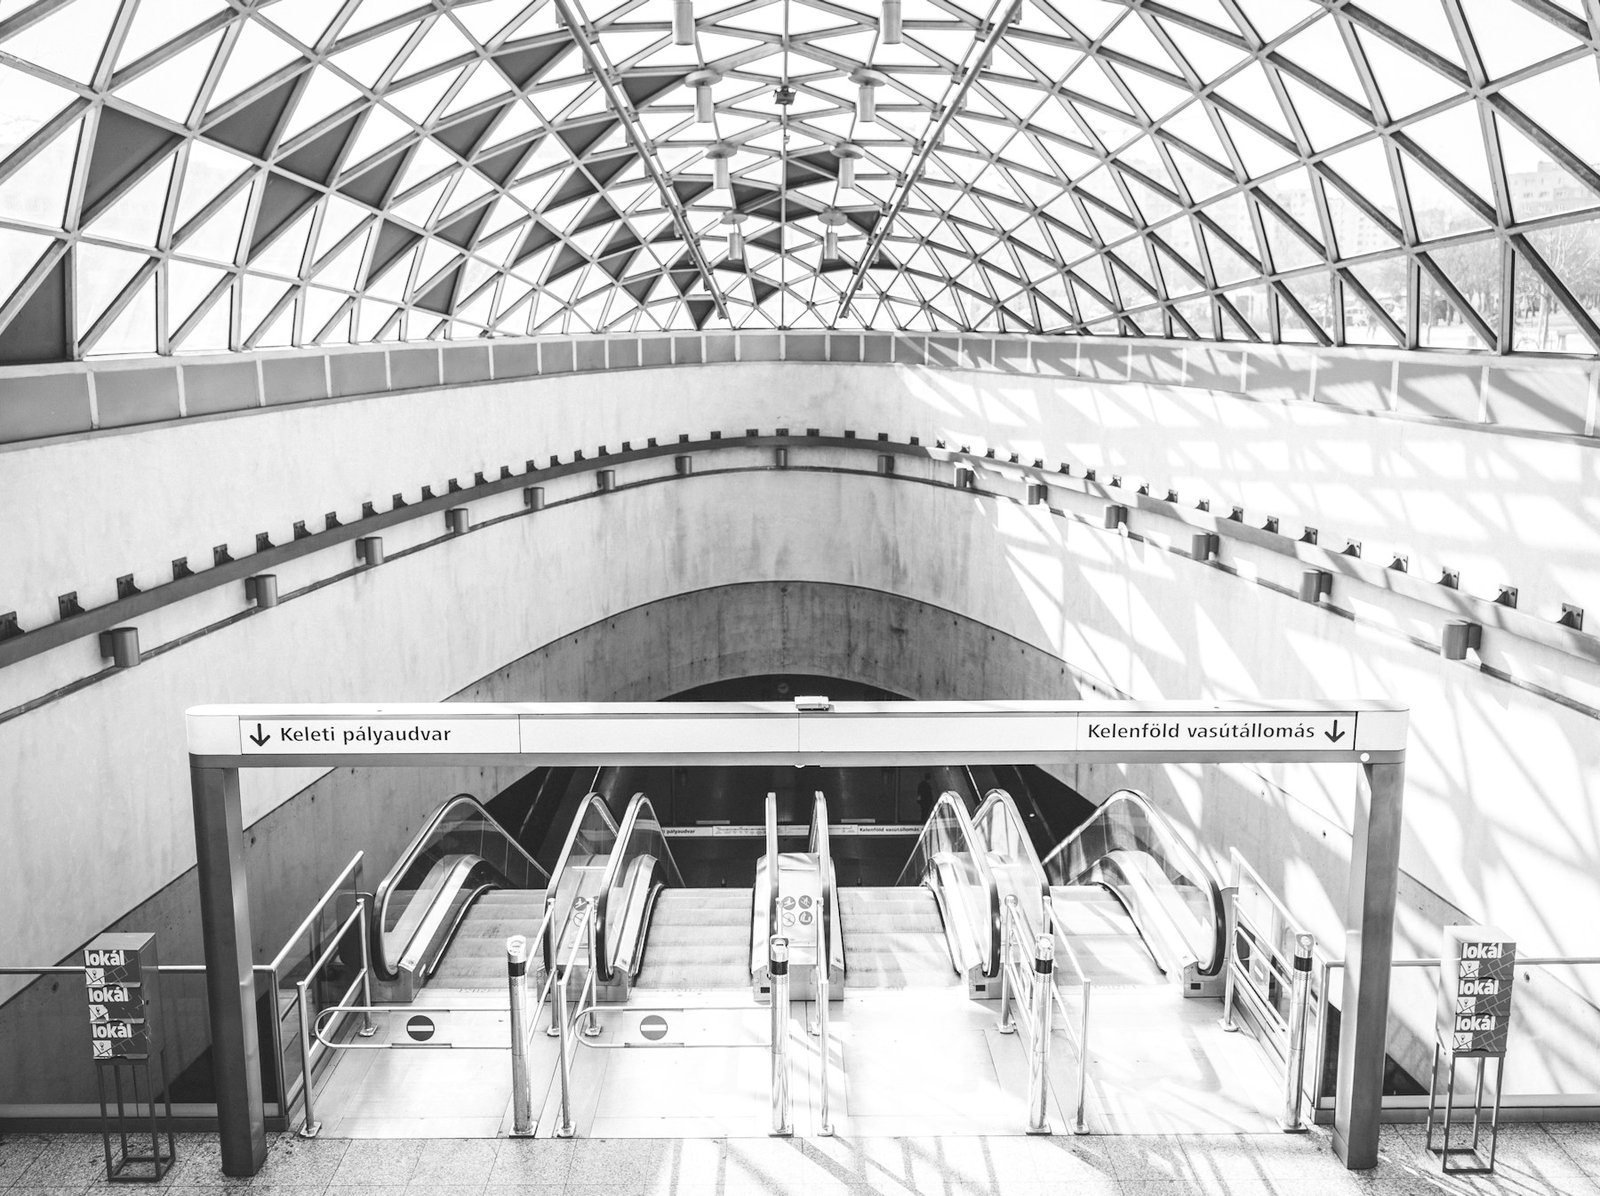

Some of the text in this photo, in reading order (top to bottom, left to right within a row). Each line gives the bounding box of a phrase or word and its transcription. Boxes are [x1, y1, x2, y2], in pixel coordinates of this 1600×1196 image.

[280, 725, 451, 745] Keleti pályaudvar
[1088, 723, 1315, 738] Kelenföld vasútállomás
[84, 950, 125, 966] lokál
[1462, 943, 1502, 959] lokál
[88, 987, 129, 1002] lokál
[1459, 980, 1499, 995] lokál
[92, 1023, 132, 1038] lokál
[1455, 1016, 1496, 1031] lokál
